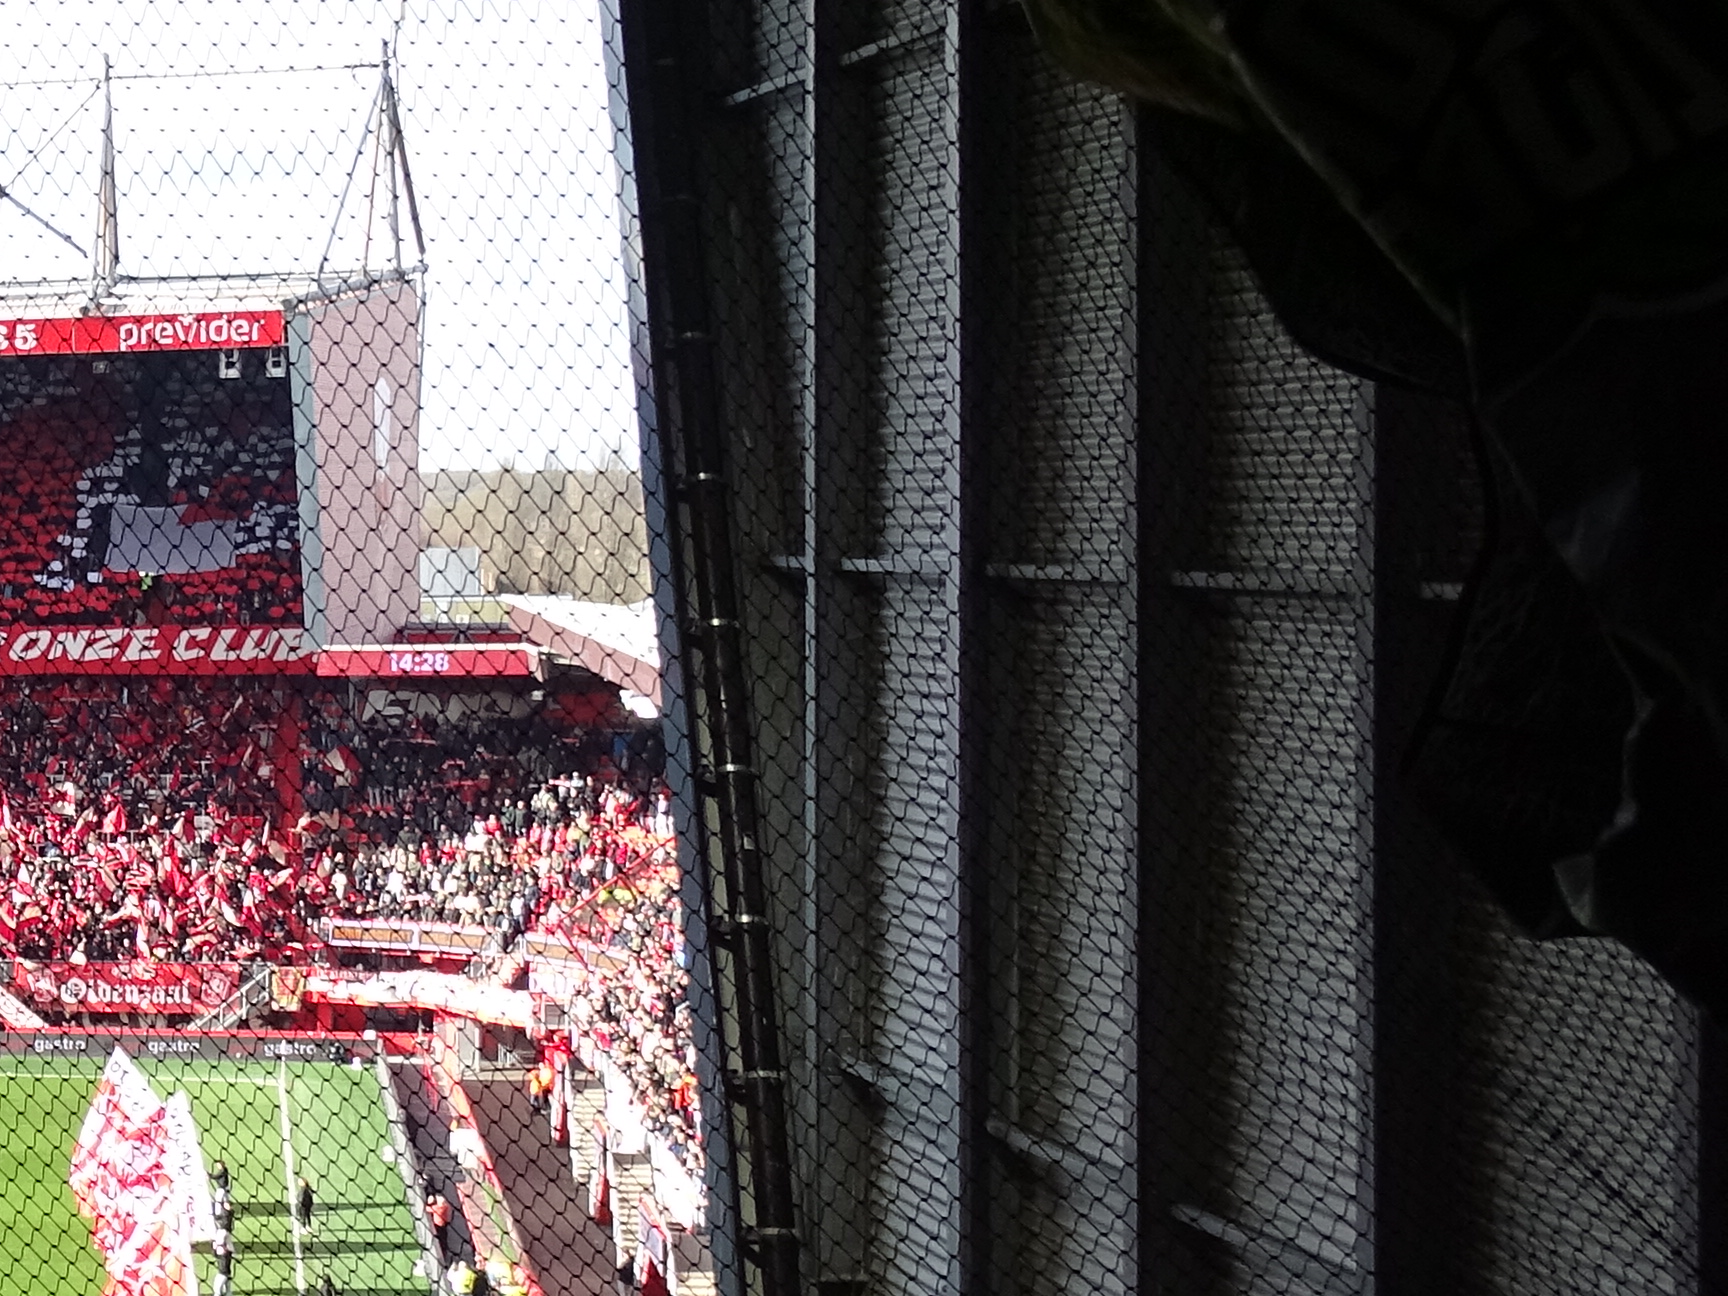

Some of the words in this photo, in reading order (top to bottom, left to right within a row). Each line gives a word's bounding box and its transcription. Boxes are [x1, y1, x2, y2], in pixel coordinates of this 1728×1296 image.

[118, 315, 265, 352] previder
[8, 628, 161, 663] ONZE
[389, 653, 449, 672] 14:28
